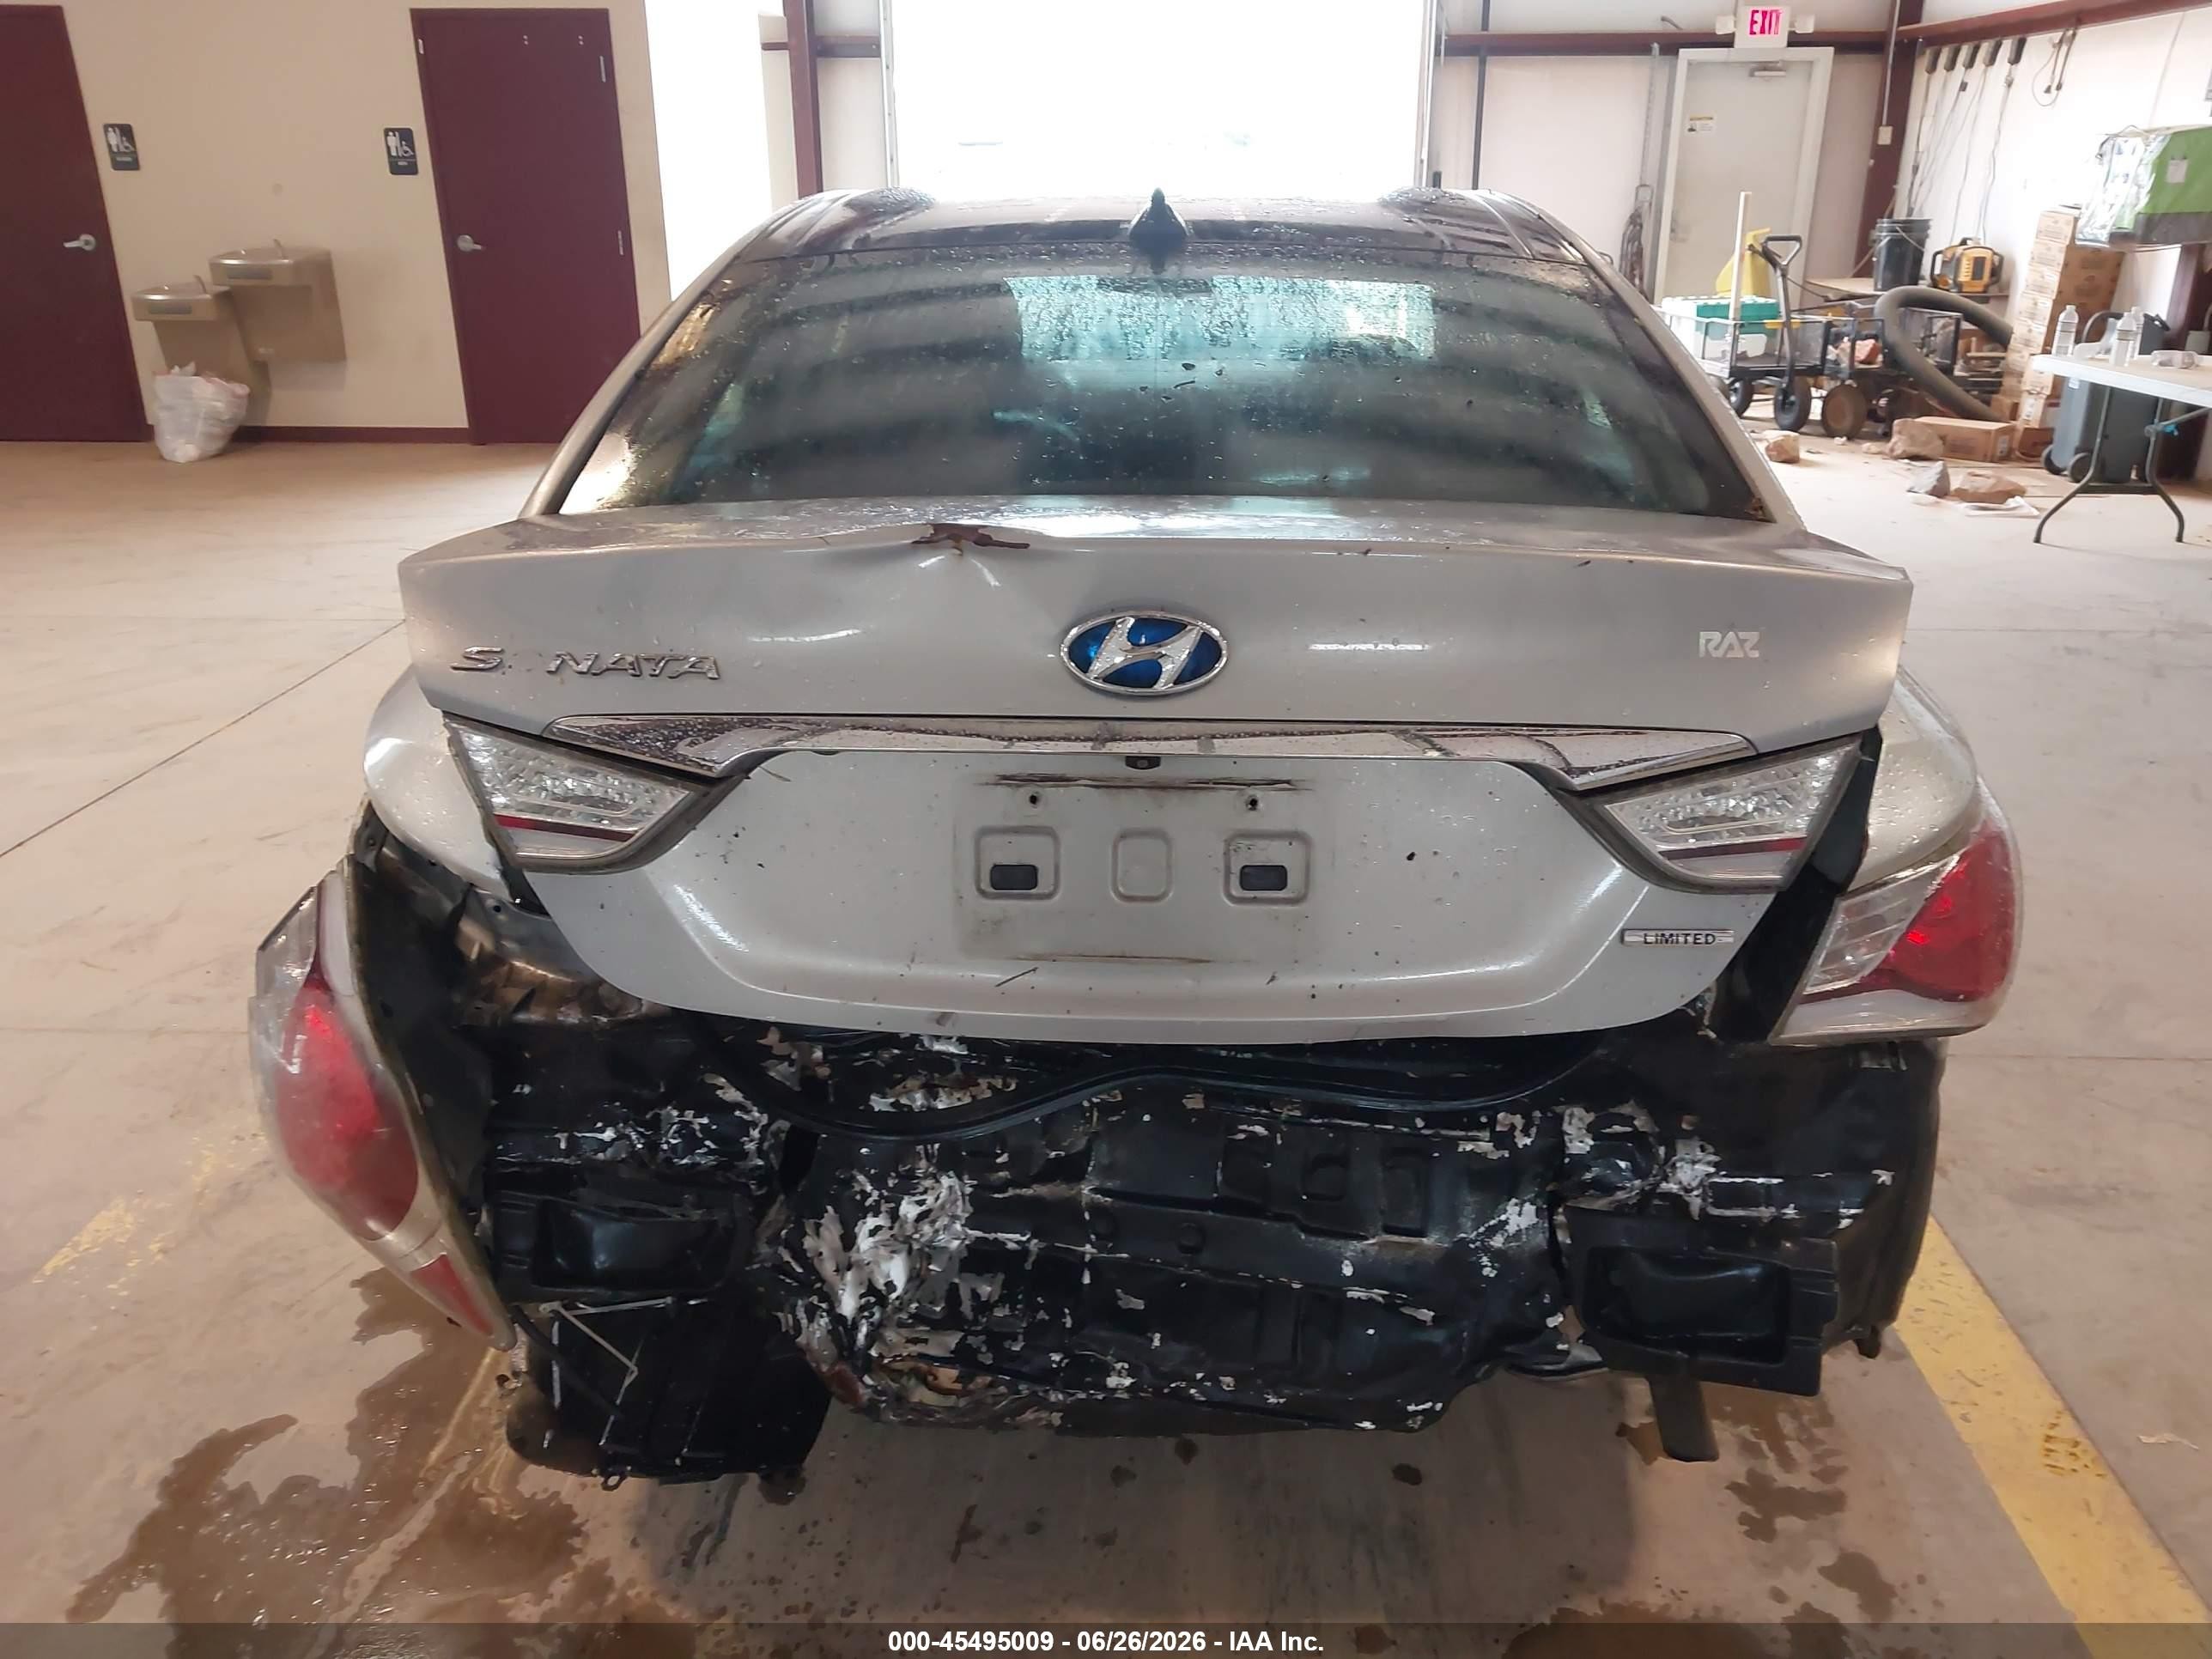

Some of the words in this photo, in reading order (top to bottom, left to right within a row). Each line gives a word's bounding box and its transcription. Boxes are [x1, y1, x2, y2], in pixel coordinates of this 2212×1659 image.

[1749, 9, 1783, 35] EXIT
[450, 646, 720, 680] SNATA
[1644, 933, 1717, 945] LIMITED
